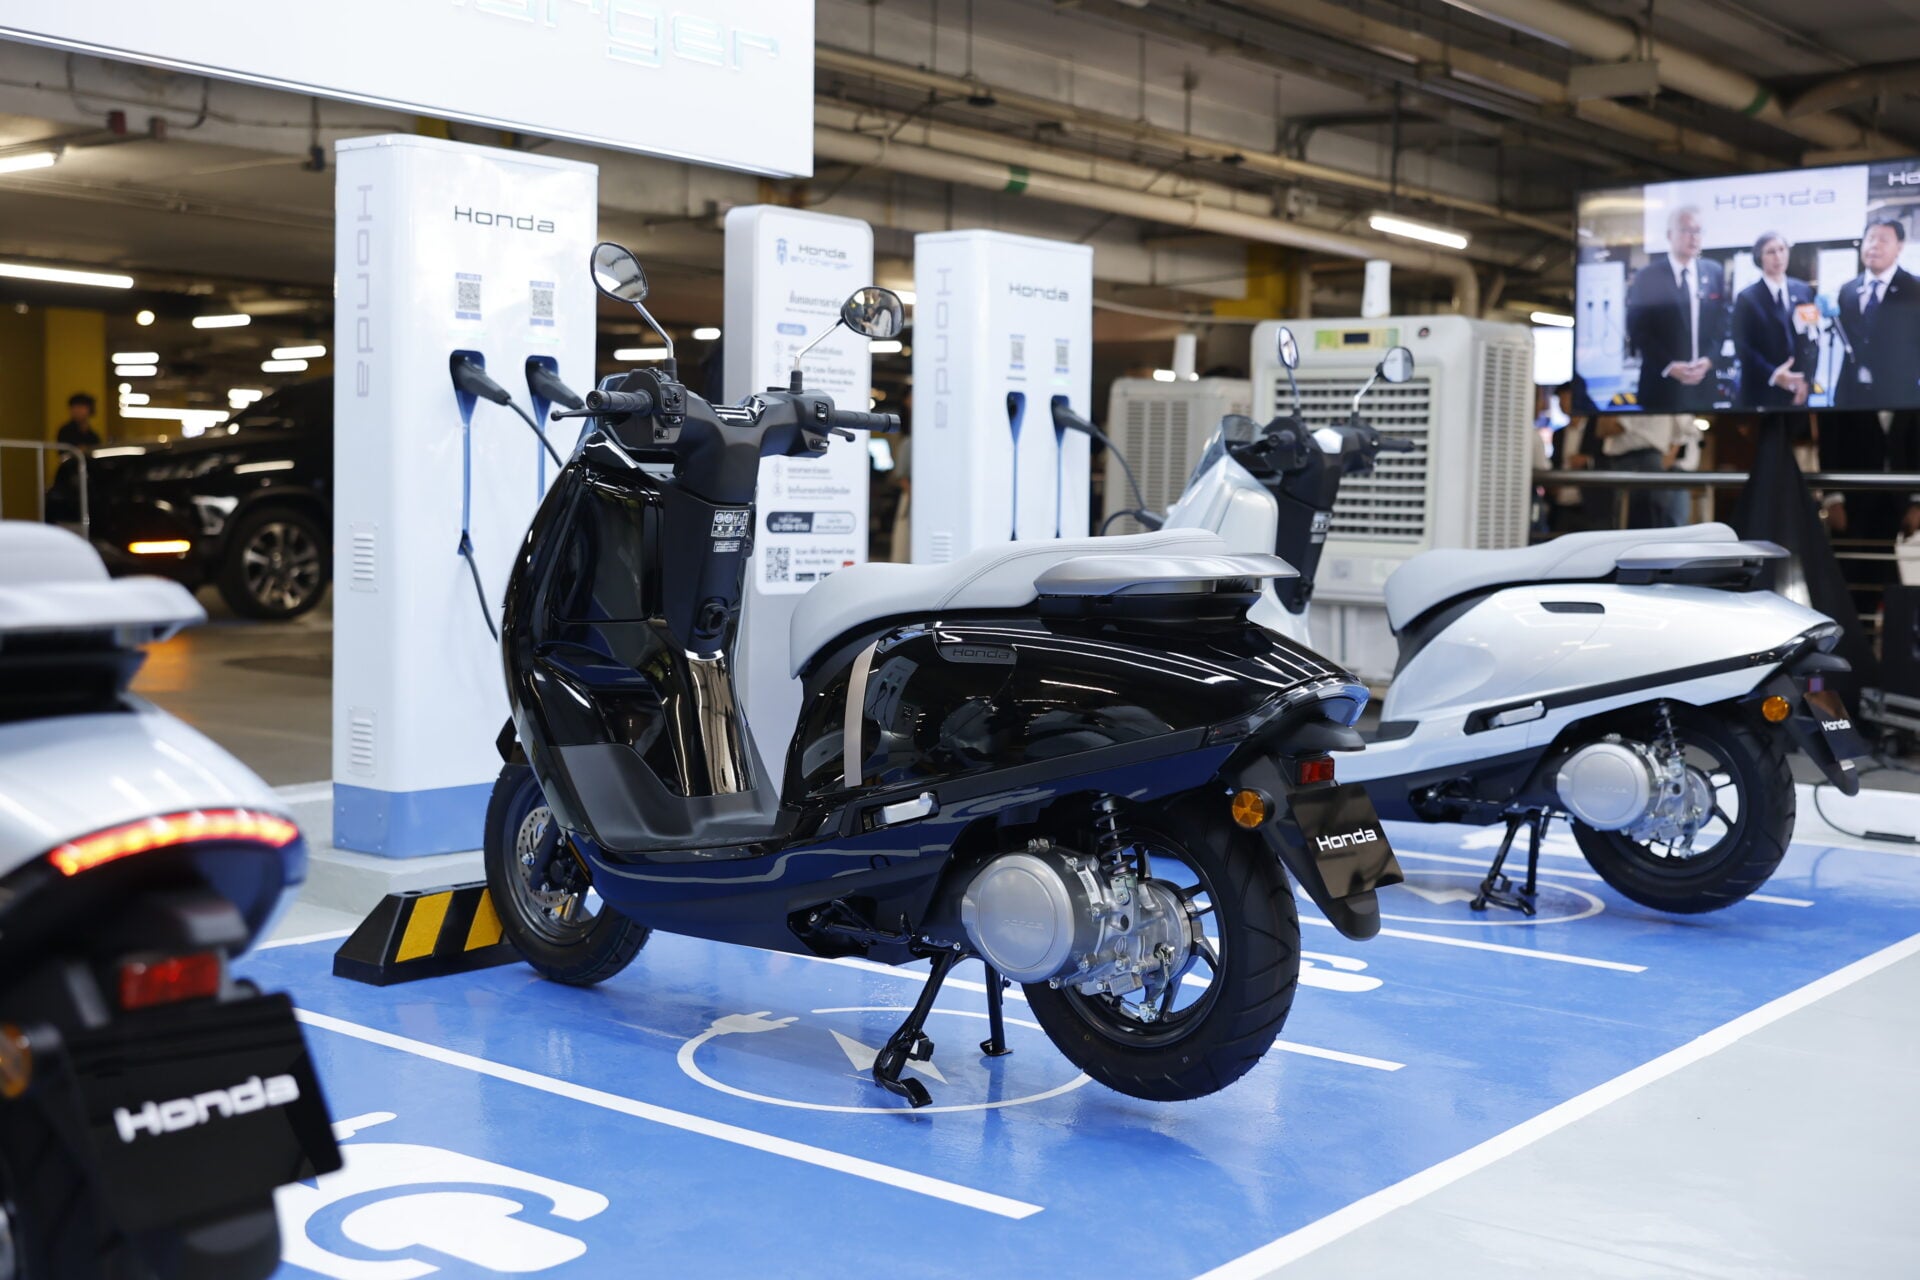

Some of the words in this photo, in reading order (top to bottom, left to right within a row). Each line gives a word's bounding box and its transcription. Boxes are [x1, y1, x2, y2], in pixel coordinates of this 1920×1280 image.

[1714, 188, 1836, 210] Honda
[455, 205, 554, 233] Honda
[799, 244, 847, 259] Honda
[357, 185, 374, 398] Honda
[1009, 283, 1069, 302] Honda
[935, 268, 952, 429] Honda
[952, 648, 1010, 659] Honda
[1821, 718, 1851, 731] Honda
[1315, 828, 1378, 851] Honda
[113, 1074, 300, 1143] Honda
